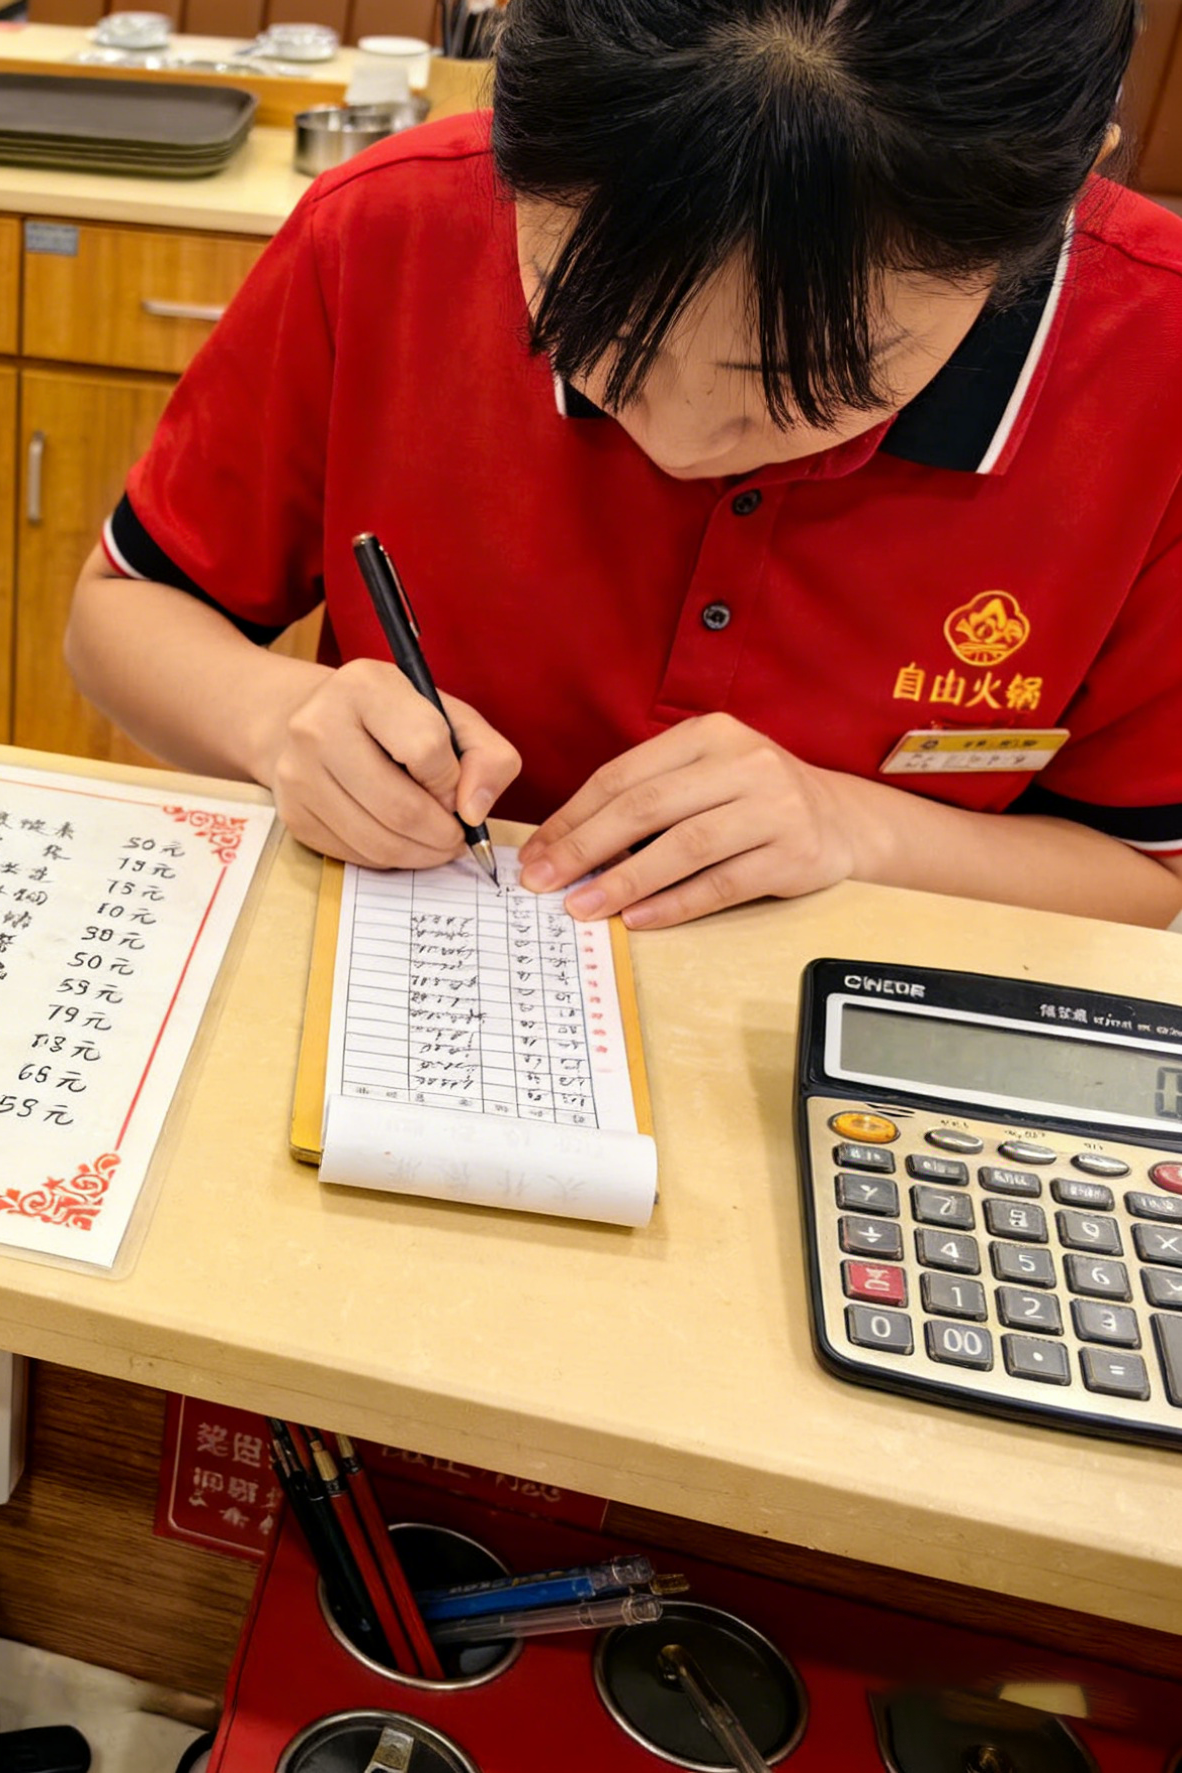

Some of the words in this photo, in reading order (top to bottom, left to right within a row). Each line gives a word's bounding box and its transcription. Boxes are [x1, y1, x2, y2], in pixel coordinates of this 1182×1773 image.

[122, 836, 186, 858] 50元
[66, 951, 135, 976] 50元
[1018, 1254, 1036, 1273] 5
[1091, 1267, 1111, 1286] 6
[951, 1286, 964, 1308] 1
[1023, 1298, 1045, 1320] 2
[870, 1315, 892, 1338] 0
[943, 1328, 984, 1356] 00
